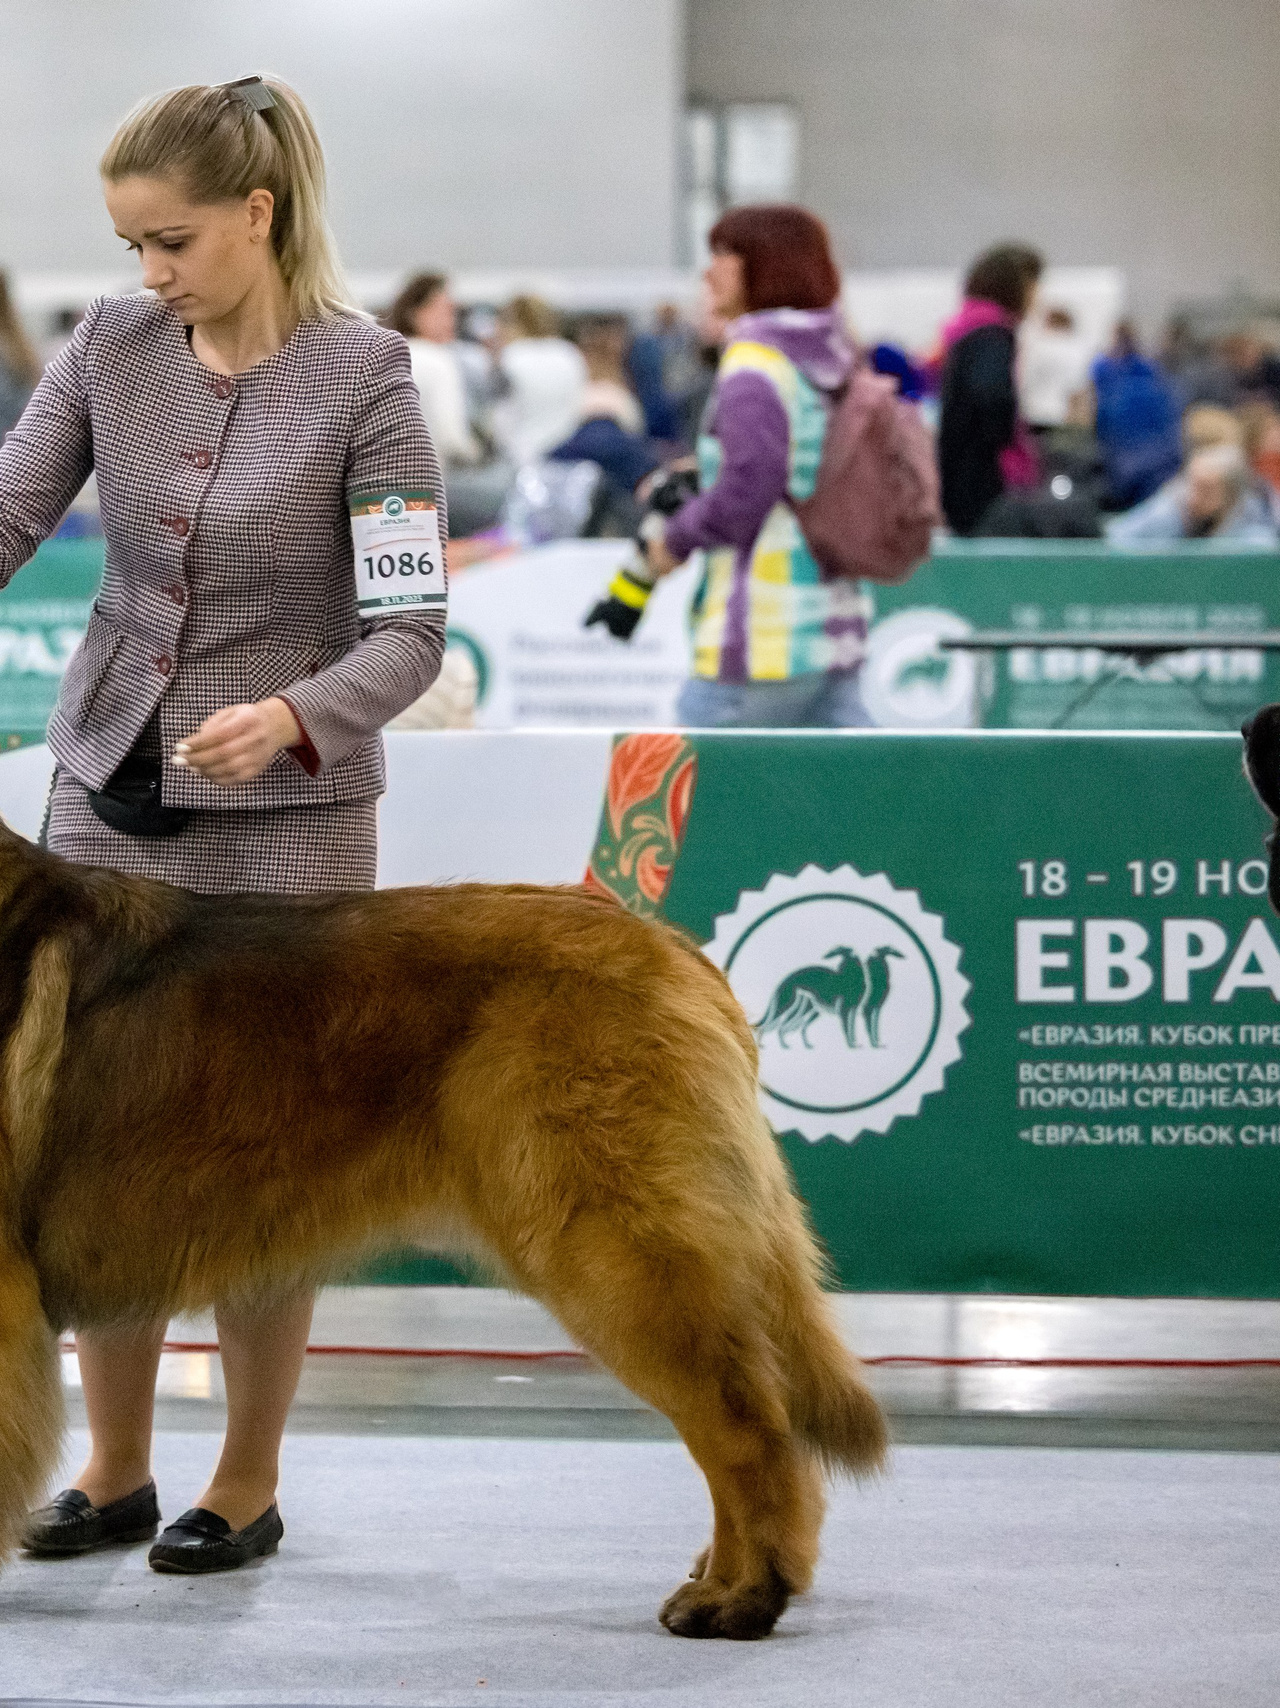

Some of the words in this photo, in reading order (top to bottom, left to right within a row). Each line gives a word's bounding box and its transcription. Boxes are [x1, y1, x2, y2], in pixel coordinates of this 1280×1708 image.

[363, 552, 434, 579] 1086
[1017, 859, 1067, 896] 18
[1126, 859, 1177, 896] 19
[1015, 917, 1280, 1003] ЕВРА
[1150, 1023, 1234, 1046] КУБОК
[1018, 1061, 1173, 1084] ВСЕМИРНАЯ
[1177, 1061, 1280, 1084] ВЫСТАВ
[1018, 1086, 1128, 1110] ПОРОДЫ
[1150, 1123, 1235, 1146] КУБОК
